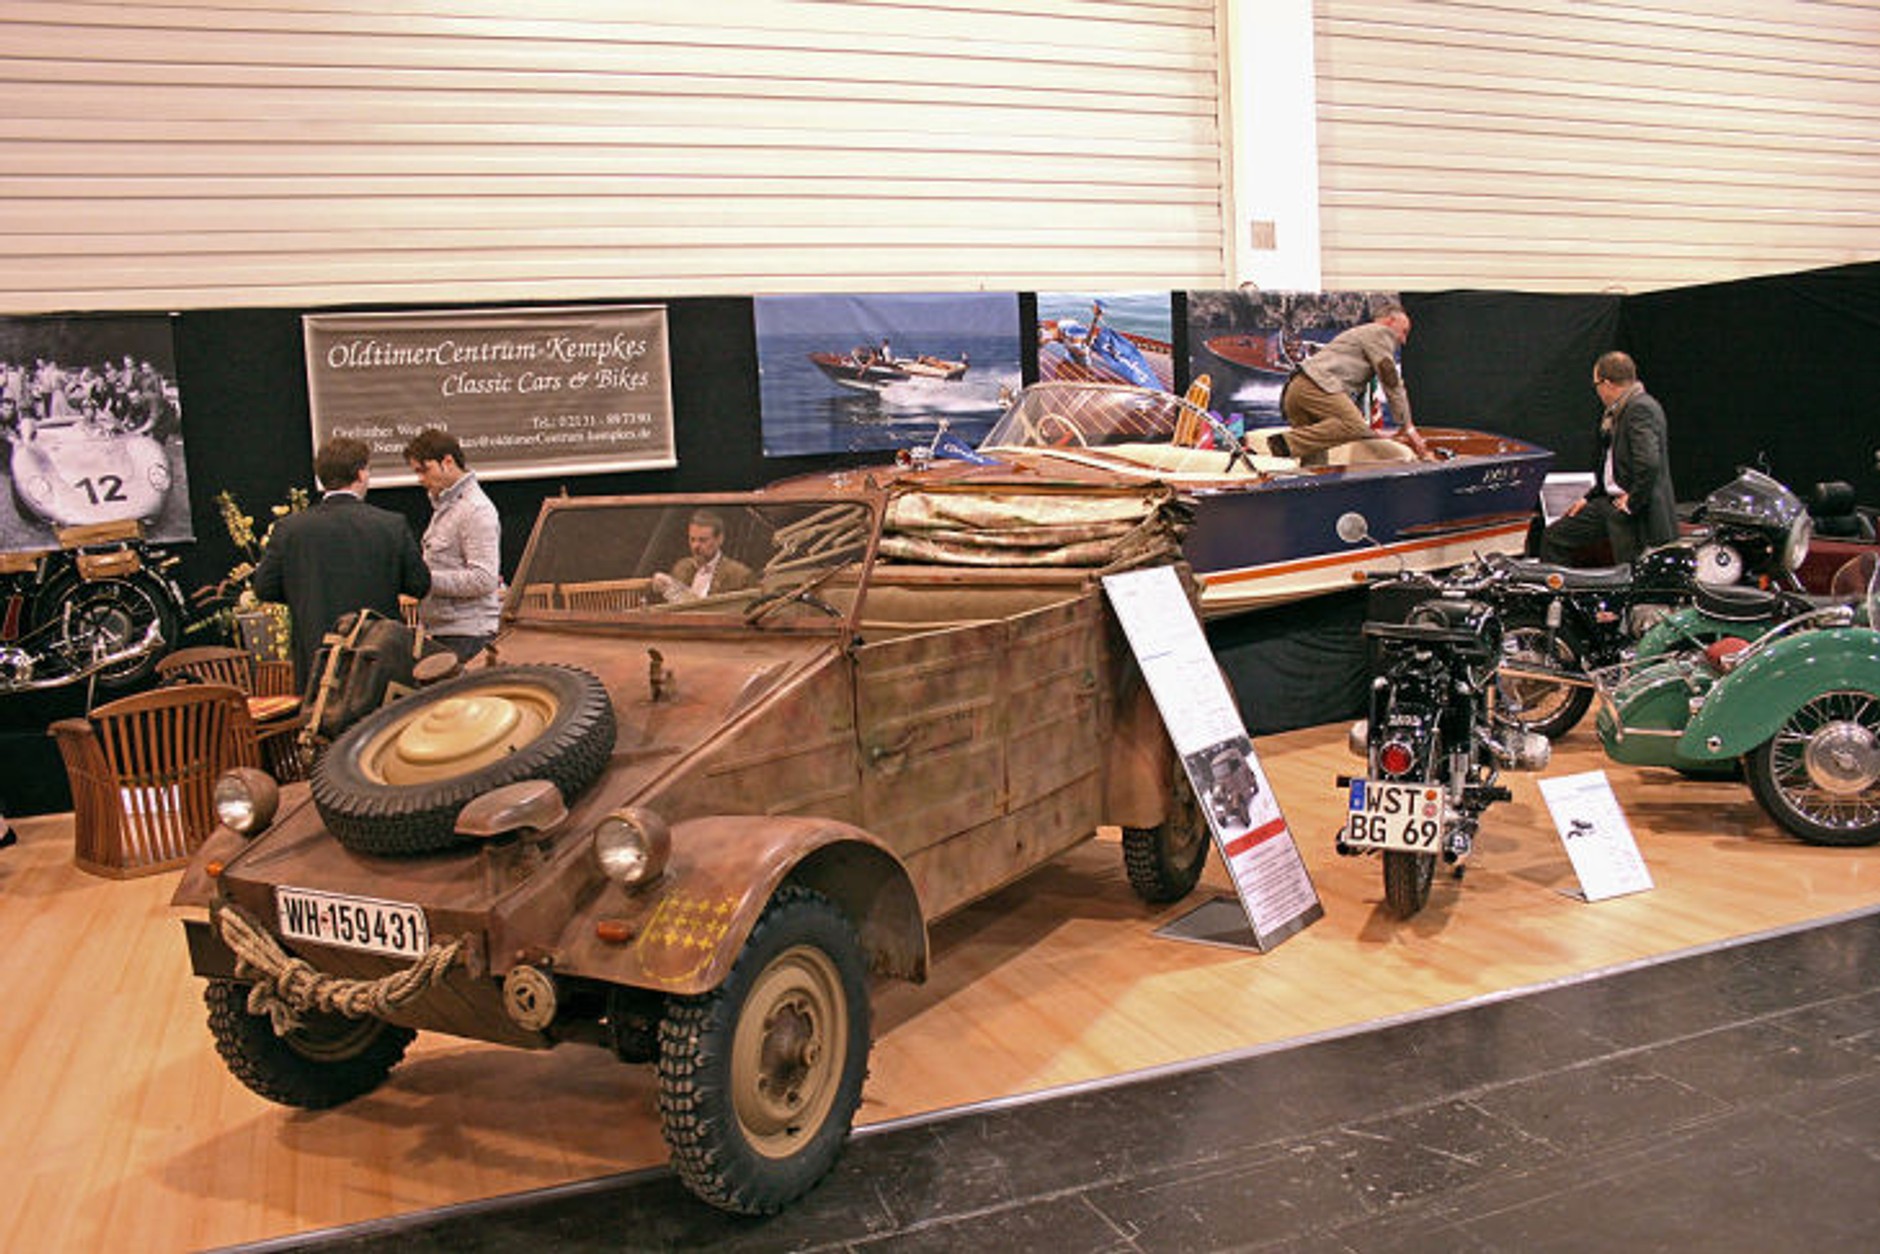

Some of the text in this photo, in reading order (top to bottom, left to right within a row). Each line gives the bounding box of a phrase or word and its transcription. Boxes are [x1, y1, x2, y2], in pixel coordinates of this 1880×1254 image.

[328, 333, 647, 368] OldtimerCentrum-Kempkes
[441, 366, 649, 396] Classic Cars & Bikes
[75, 475, 127, 505] 12
[1366, 785, 1422, 816] WST
[1350, 814, 1438, 847] BG 69
